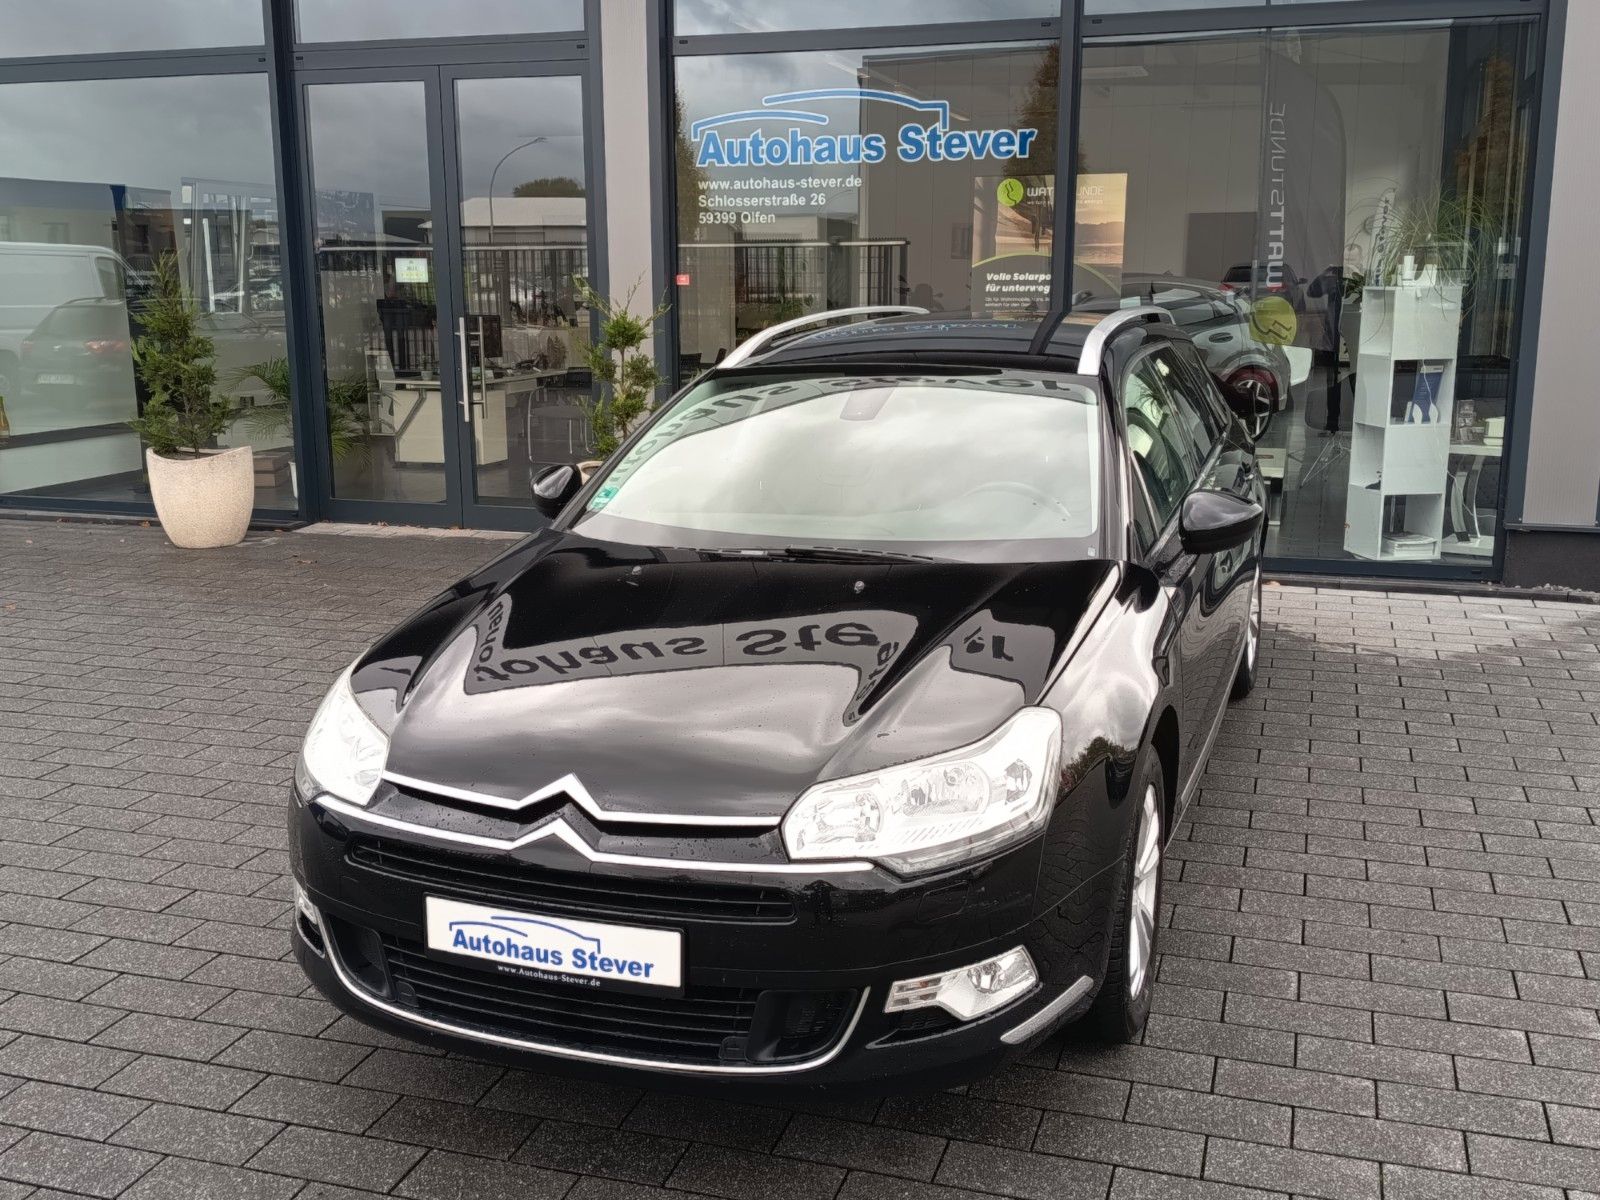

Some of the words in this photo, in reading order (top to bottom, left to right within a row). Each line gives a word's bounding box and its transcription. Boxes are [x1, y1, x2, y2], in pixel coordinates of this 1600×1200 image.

[696, 127, 886, 167] Autohaus
[897, 122, 1038, 162] Stever
[698, 174, 862, 191] www.autohaus-stever.de
[698, 193, 806, 208] Schlosserstraße
[810, 193, 827, 206] 26
[698, 212, 737, 225] 59399
[740, 211, 776, 224] Olfen
[986, 272, 1011, 281] Volle
[1012, 272, 1052, 283] Solarpo
[985, 284, 1001, 292] für
[1002, 284, 1050, 294] unterweg
[453, 928, 564, 966] Autohaus
[572, 948, 654, 978] Stever
[497, 964, 601, 987] www.Autohaus-Stever.de
